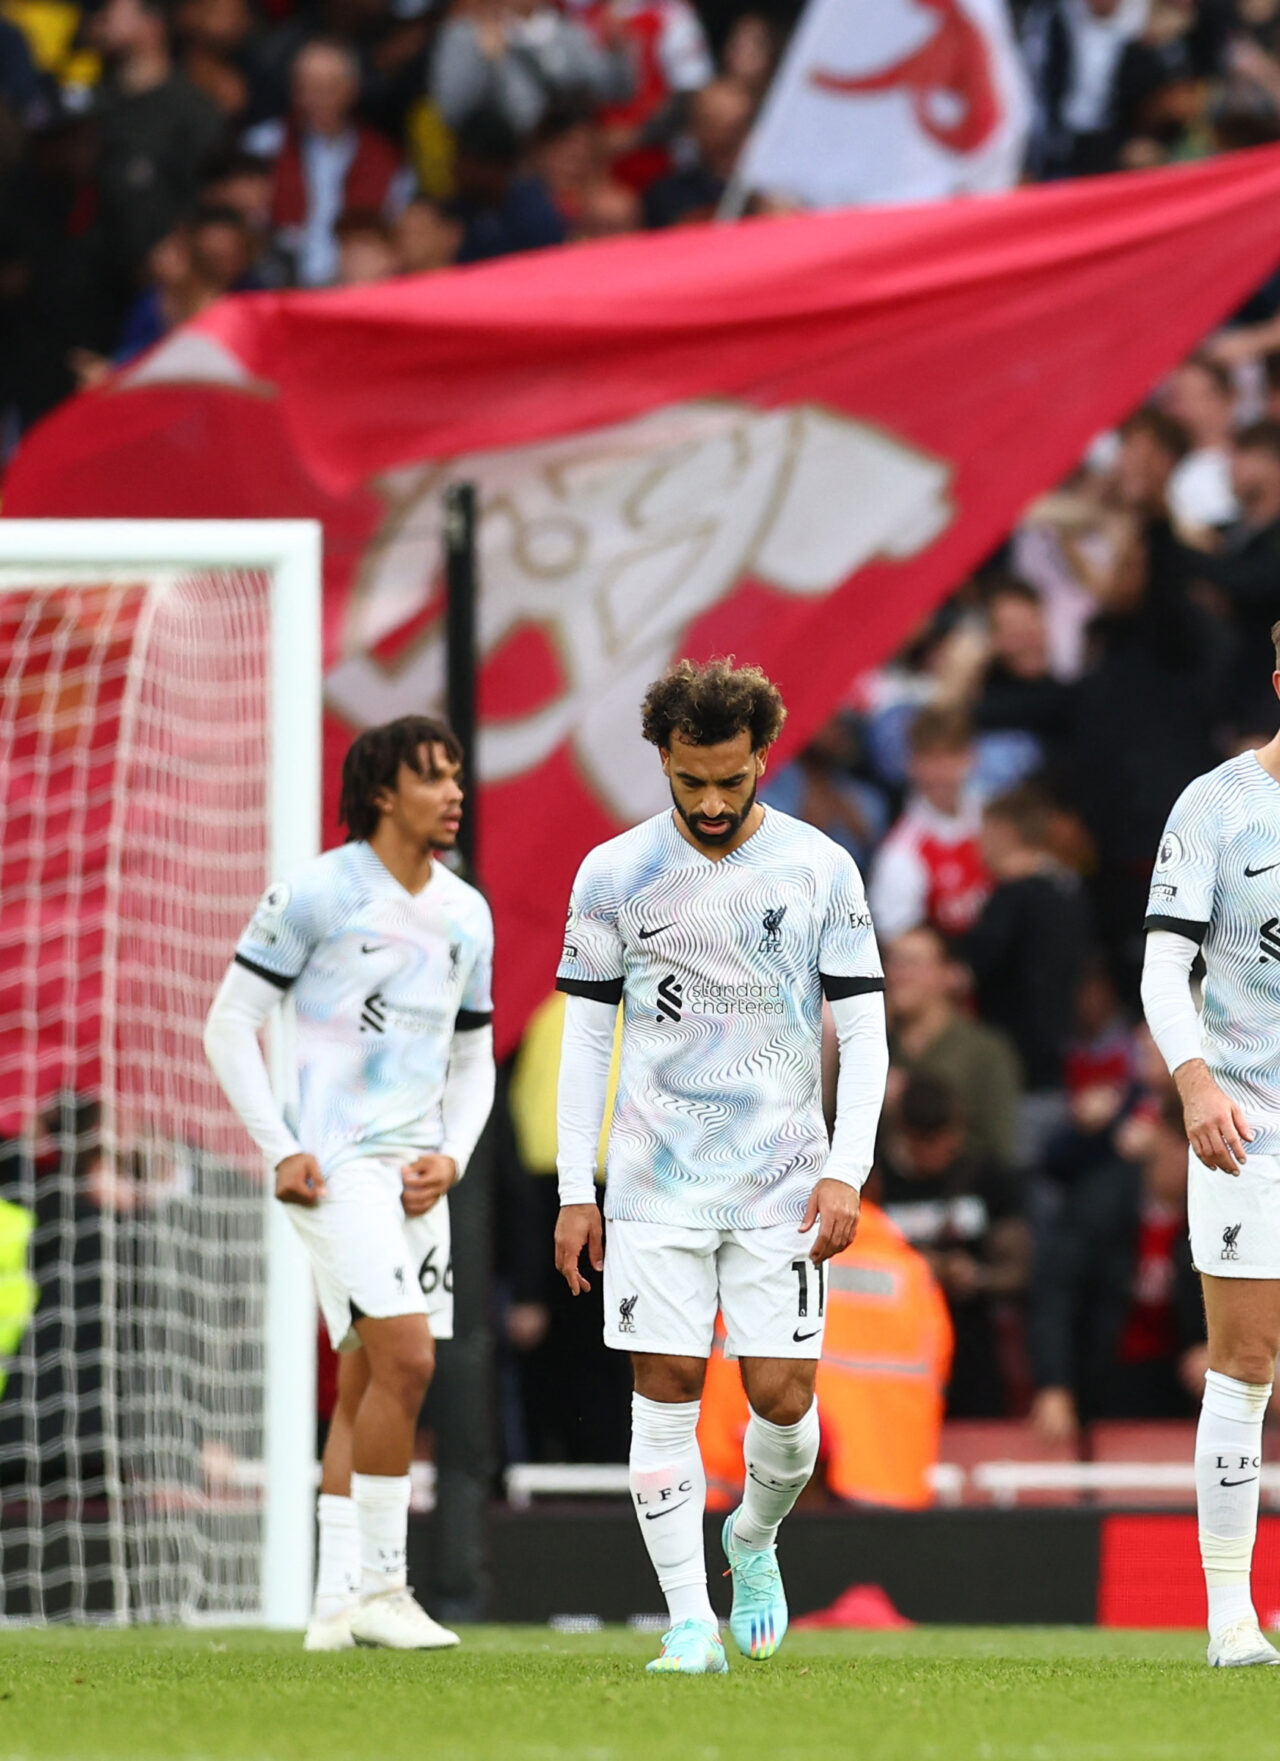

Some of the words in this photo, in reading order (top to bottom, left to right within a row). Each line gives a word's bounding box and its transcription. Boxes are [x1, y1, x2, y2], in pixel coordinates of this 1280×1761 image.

[692, 982, 780, 998] standard
[691, 1000, 784, 1015] chartered
[792, 1261, 824, 1317] 11
